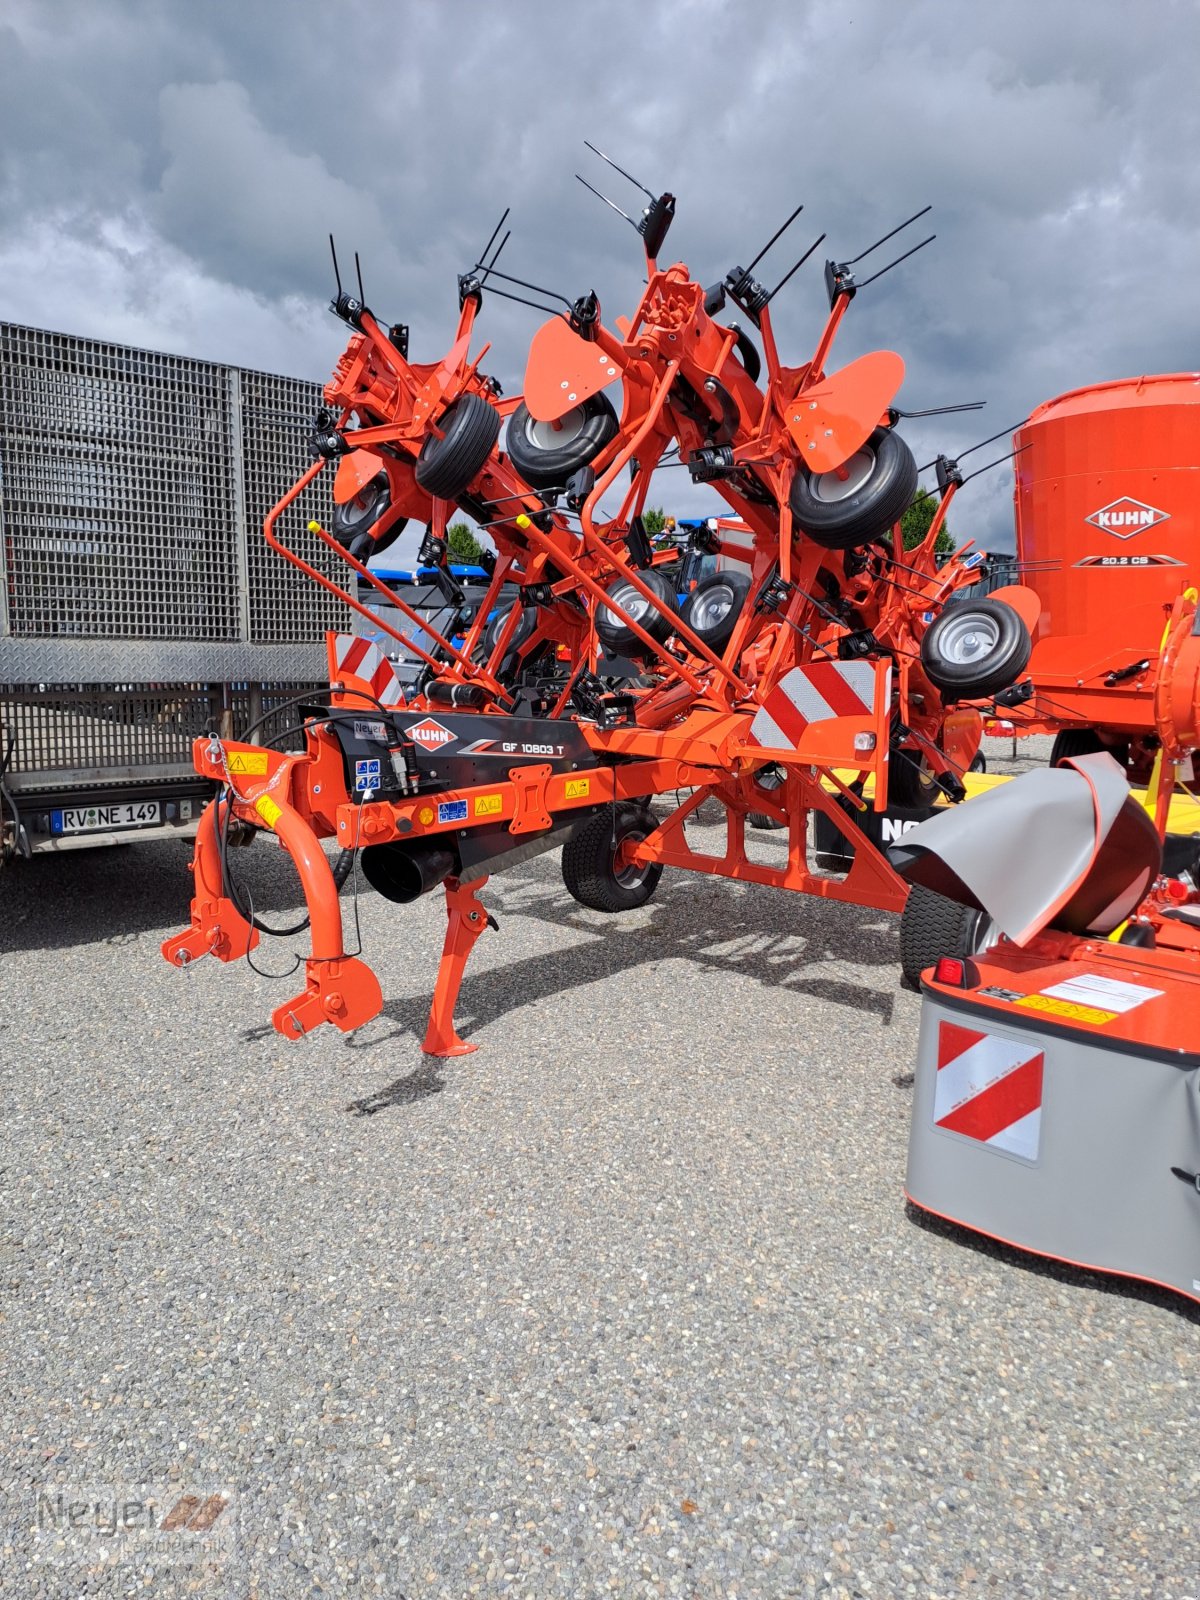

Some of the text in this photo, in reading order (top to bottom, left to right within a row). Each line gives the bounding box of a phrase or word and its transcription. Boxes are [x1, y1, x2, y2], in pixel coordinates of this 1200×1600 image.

[1098, 510, 1154, 526] KUHN
[1102, 556, 1148, 565] 20.2 CS
[411, 728, 449, 742] KUHN
[502, 742, 564, 755] GF 10803 T
[63, 803, 157, 828] RV NE 149
